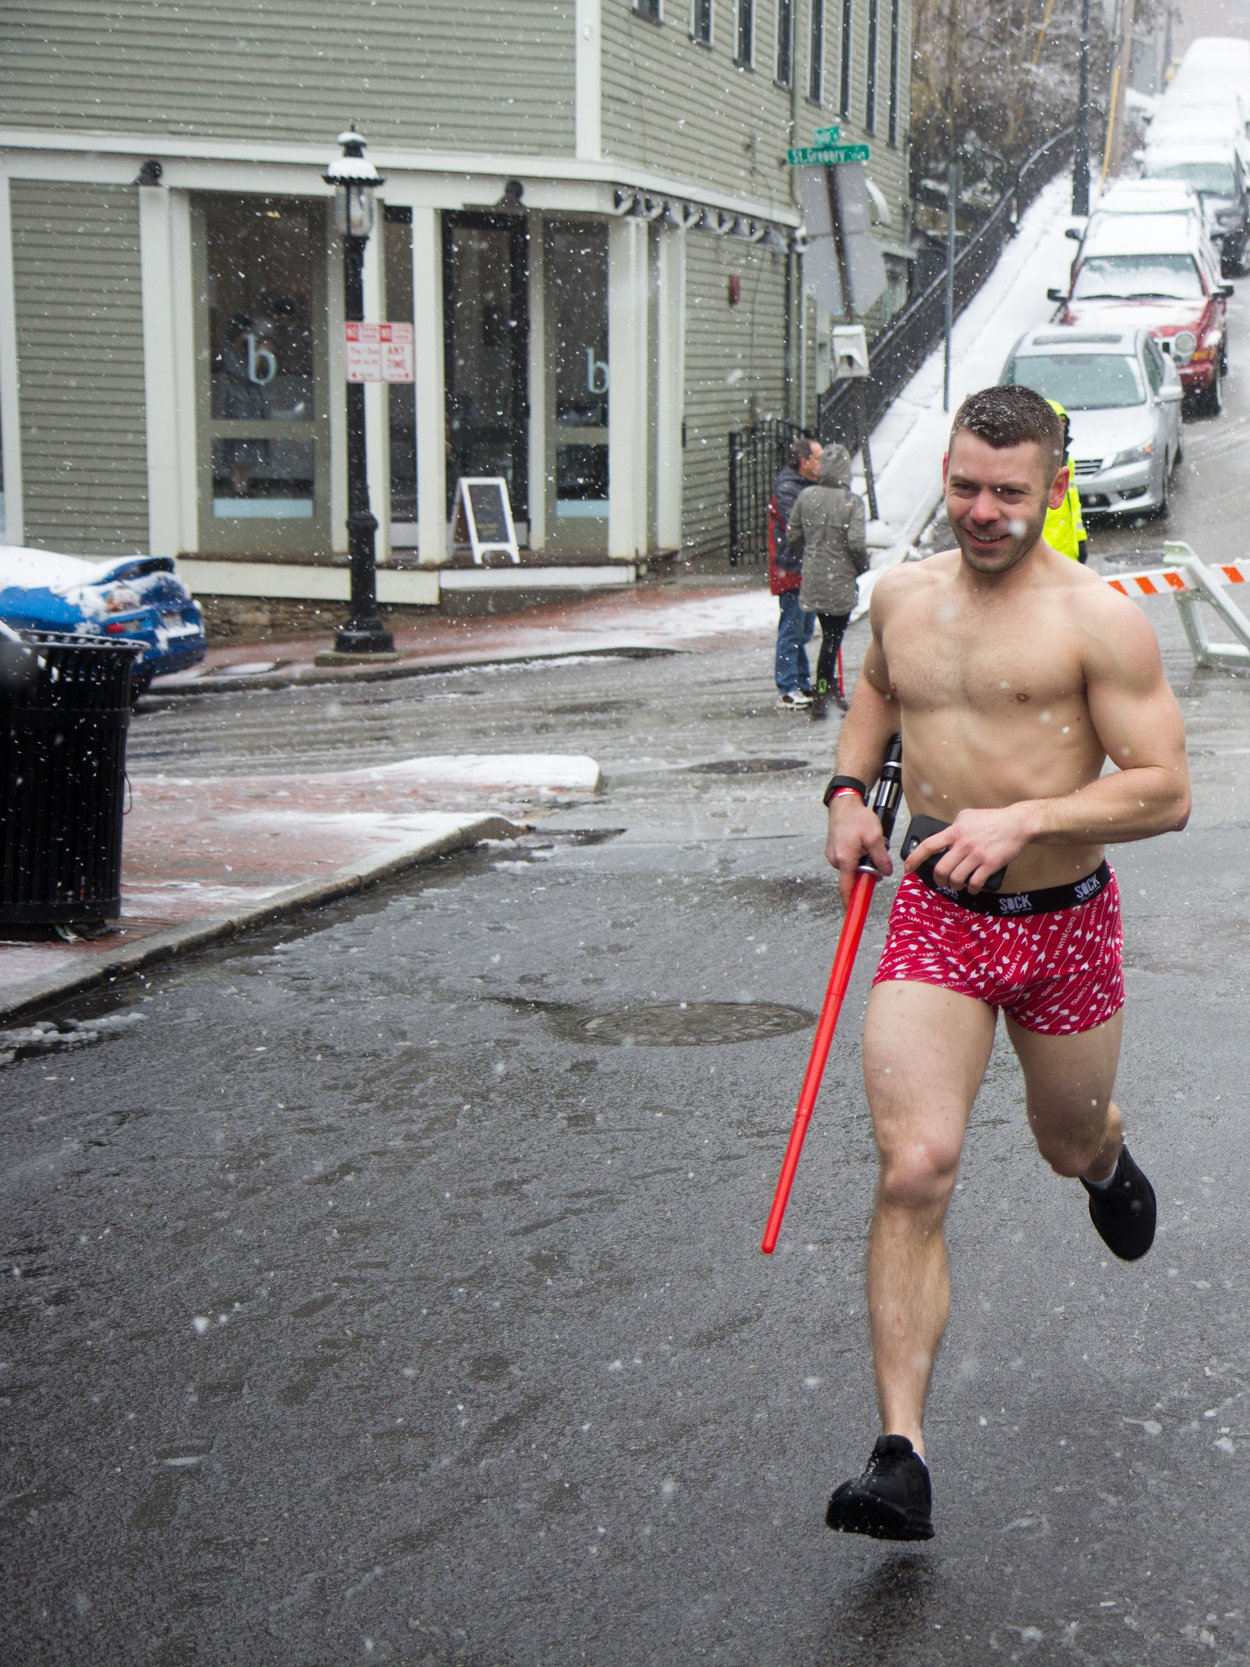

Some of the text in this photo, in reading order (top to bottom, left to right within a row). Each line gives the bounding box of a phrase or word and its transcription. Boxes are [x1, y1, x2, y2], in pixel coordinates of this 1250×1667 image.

[245, 332, 278, 385] b
[585, 346, 609, 394] b
[1056, 932, 1070, 949] WITH
[1064, 916, 1077, 934] CUPID
